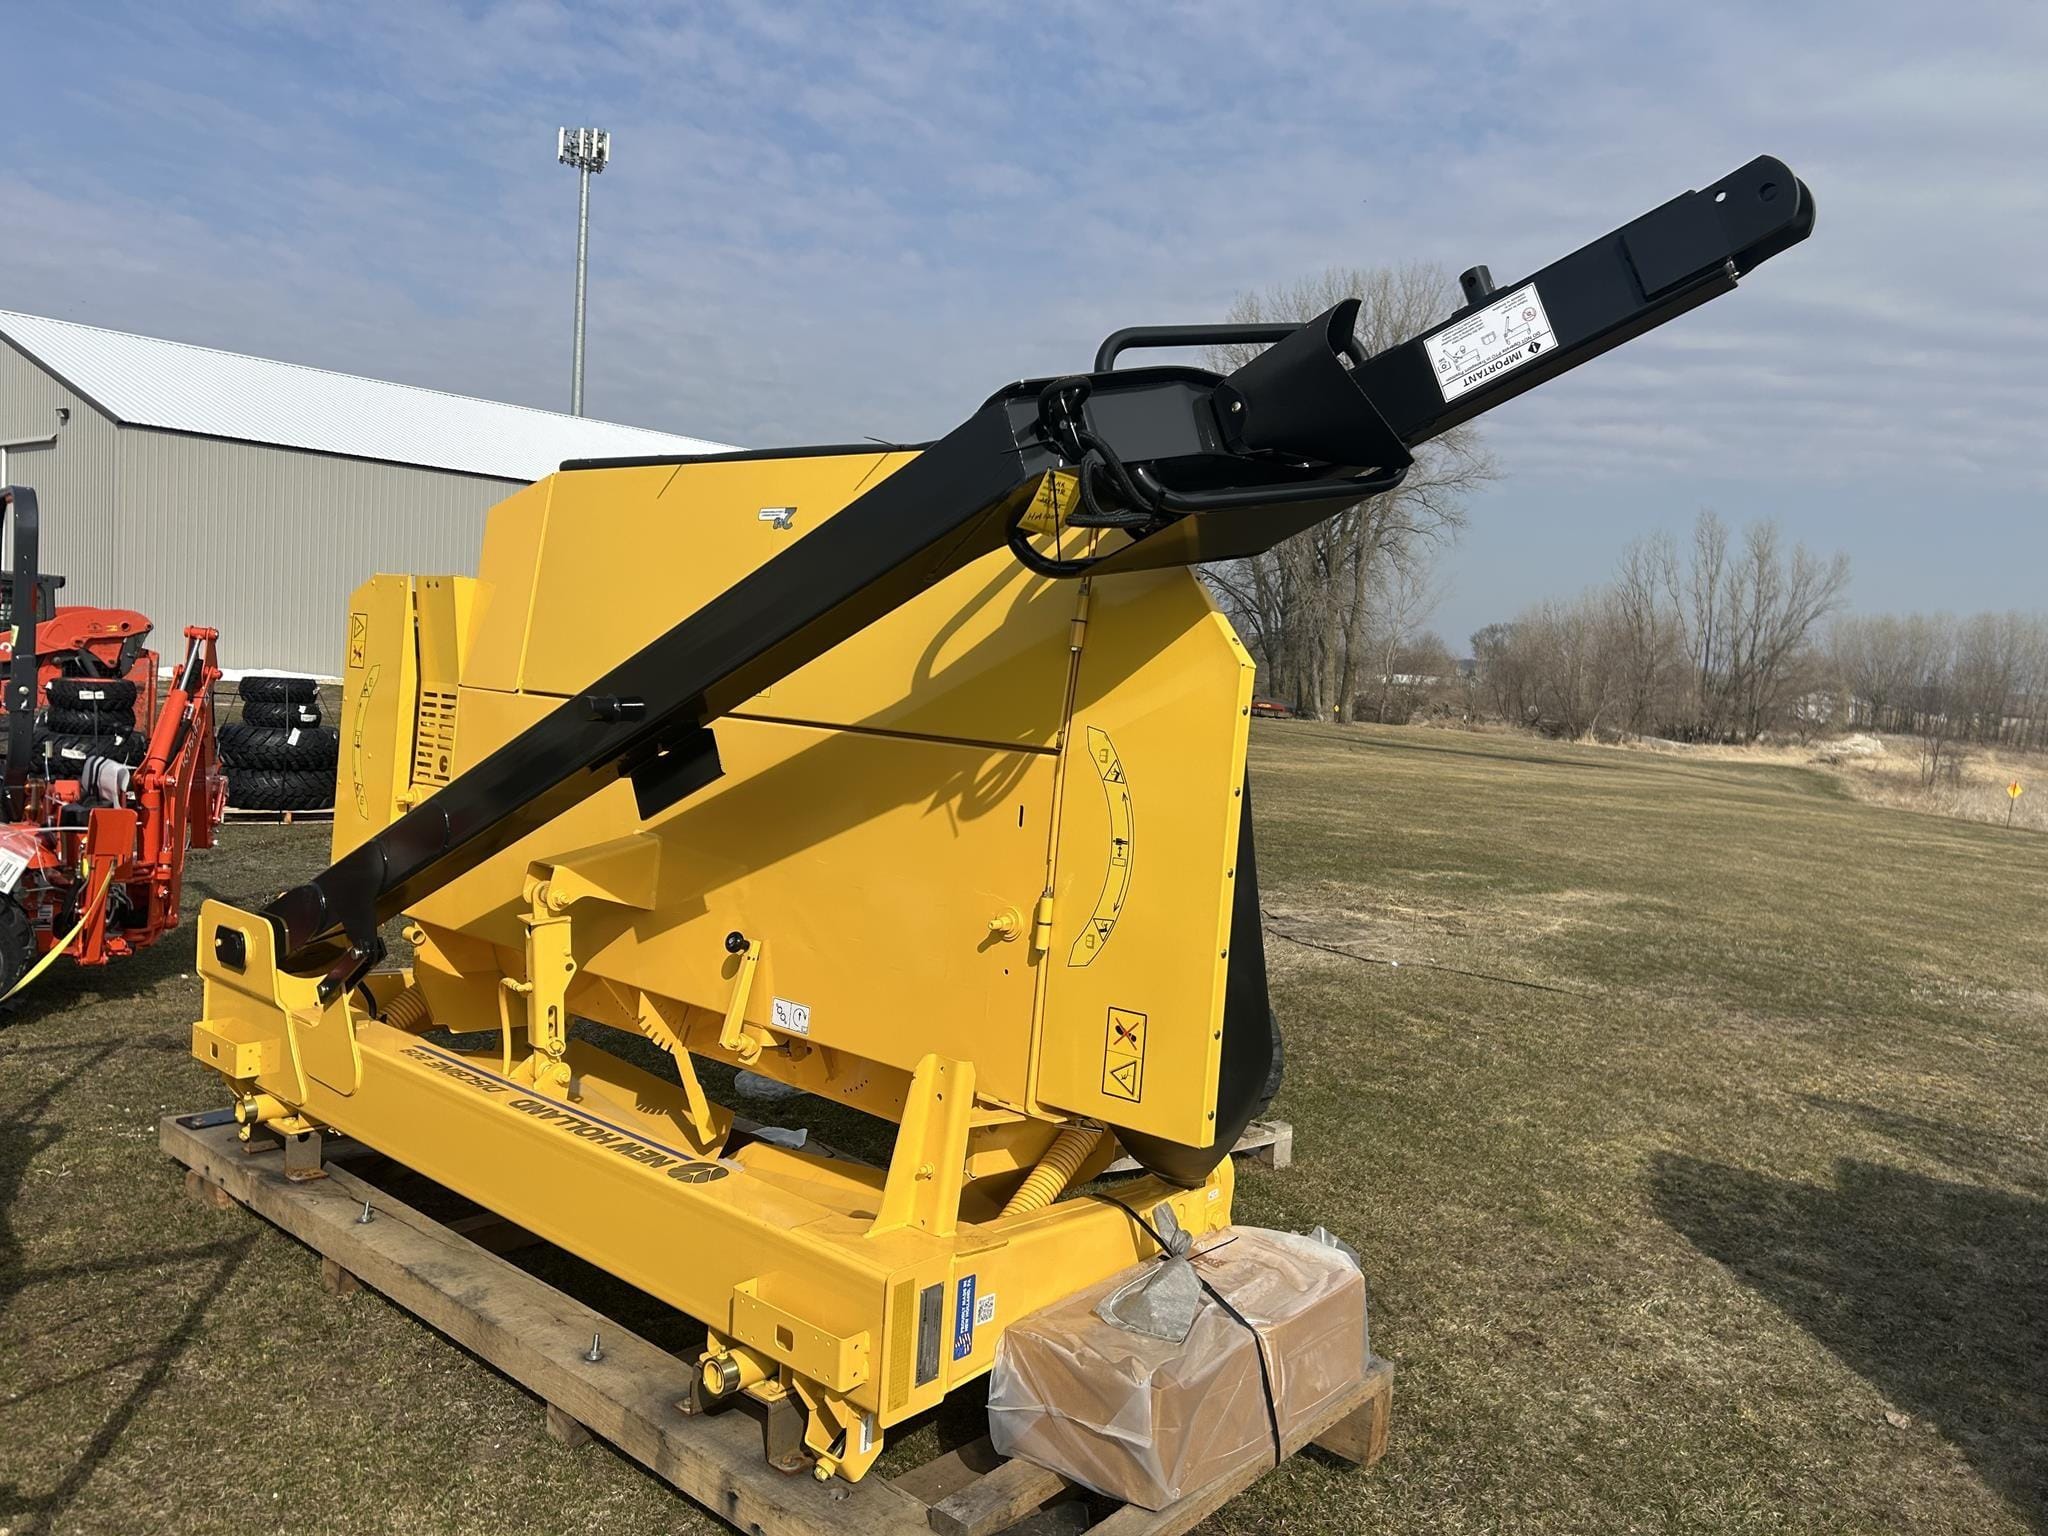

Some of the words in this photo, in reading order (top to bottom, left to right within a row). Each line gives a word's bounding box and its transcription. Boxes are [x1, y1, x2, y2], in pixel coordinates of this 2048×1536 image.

[1463, 350, 1522, 387] IMPORTANT
[422, 1062, 509, 1093] DISCBINE
[508, 1099, 623, 1146] HOLLAND
[607, 1142, 678, 1169] NEW
